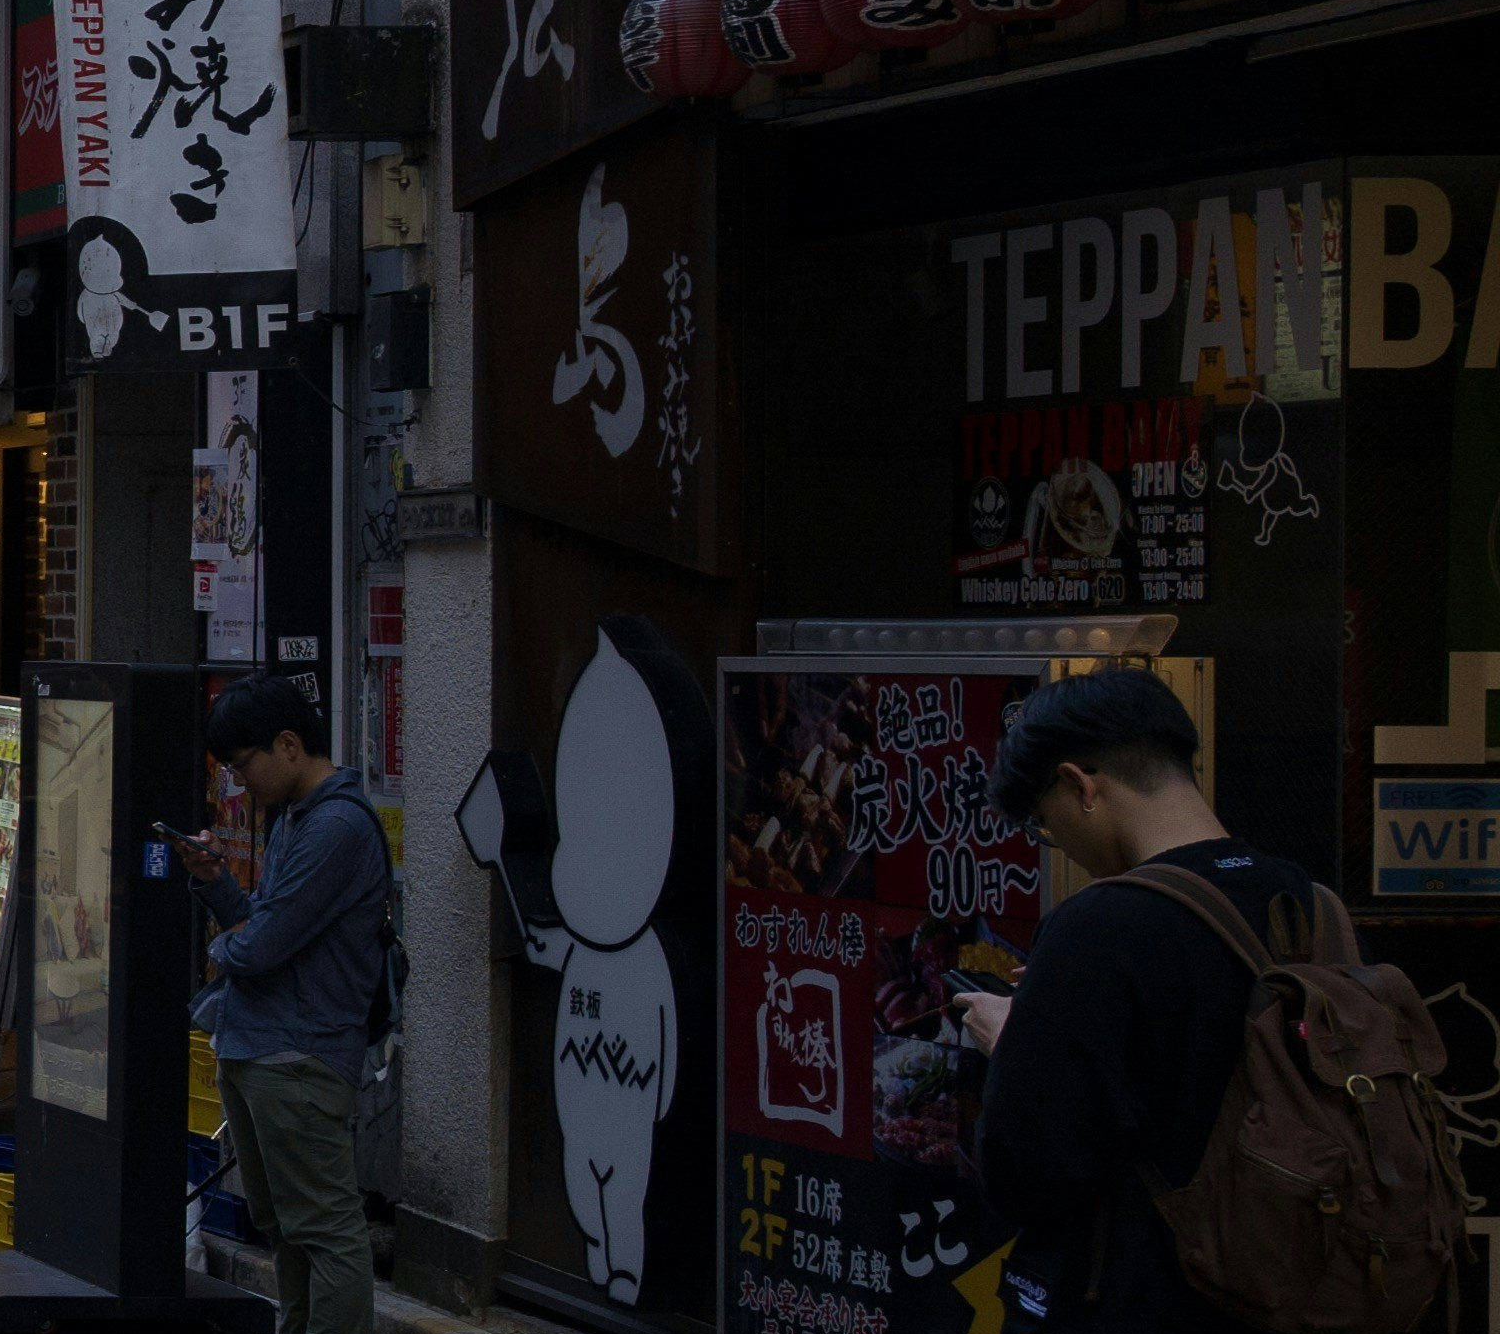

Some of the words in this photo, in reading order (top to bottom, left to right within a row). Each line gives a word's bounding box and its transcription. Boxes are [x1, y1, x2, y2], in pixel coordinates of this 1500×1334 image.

[178, 303, 290, 352] B1F
[658, 251, 702, 519] お好み焼き
[1130, 461, 1177, 498] OPEN
[1390, 790, 1440, 808] FREE
[735, 902, 866, 969] わすれん棒
[570, 986, 602, 1019] 鉄板
[741, 1155, 786, 1205] 1F
[794, 1175, 843, 1225] 16席
[740, 1207, 788, 1261] 2F
[792, 1231, 843, 1277] 52席
[848, 1245, 894, 1296] 座敷
